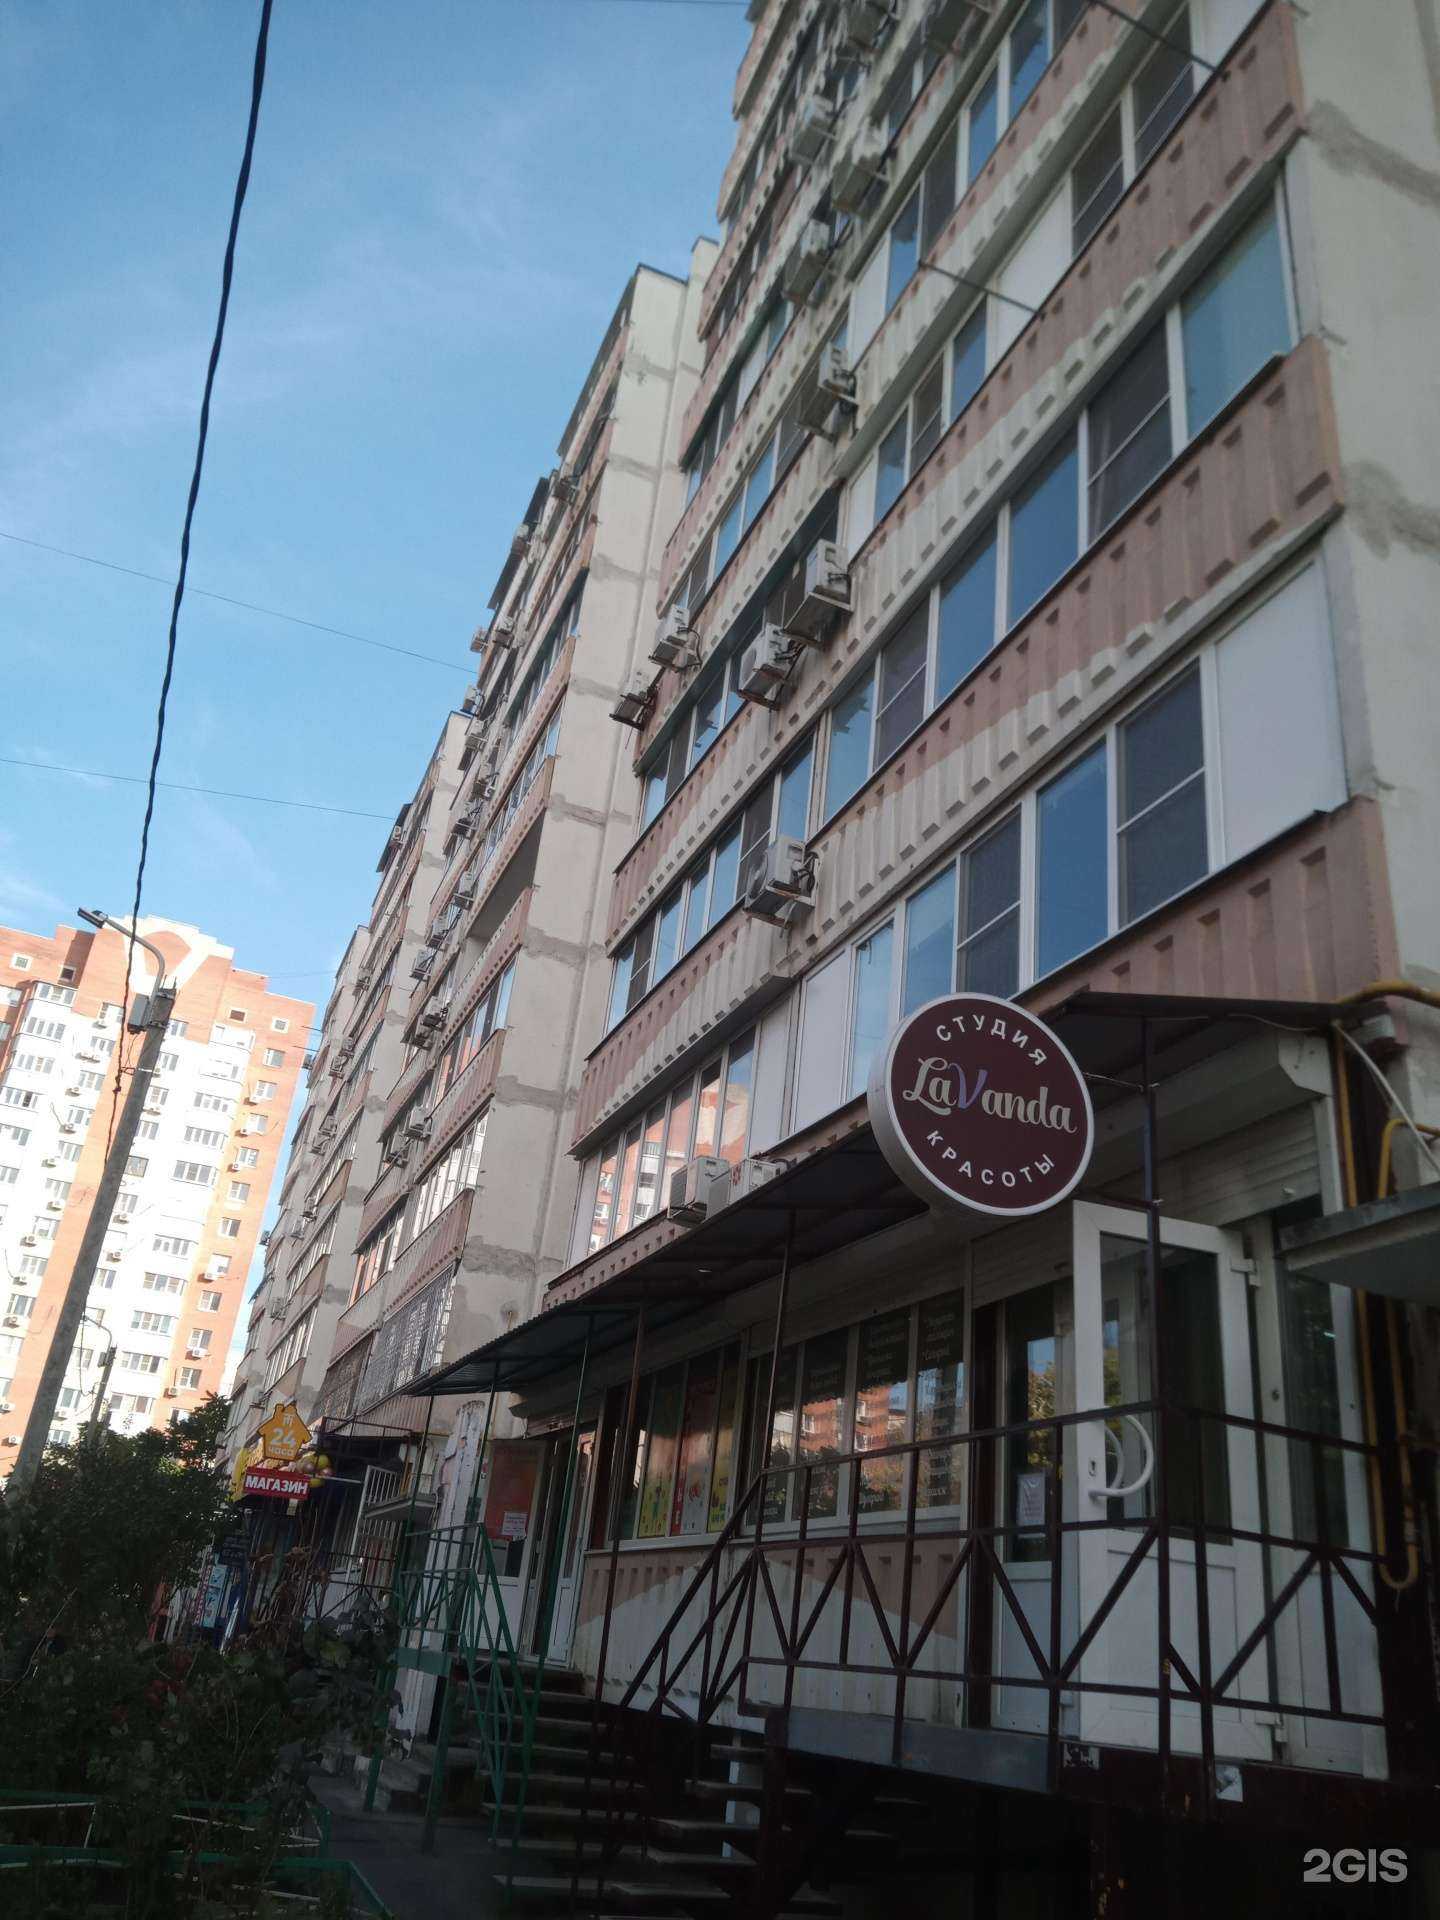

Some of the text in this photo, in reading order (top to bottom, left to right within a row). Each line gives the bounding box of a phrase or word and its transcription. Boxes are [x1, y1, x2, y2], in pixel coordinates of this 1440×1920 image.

[936, 1014, 1047, 1066] СТУДИЯ
[902, 1057, 1077, 1134] LaVanda
[926, 1130, 1054, 1187] КРАСОТЫ
[271, 1427, 296, 1447] 24
[245, 1475, 308, 1495] МАГАЗИН
